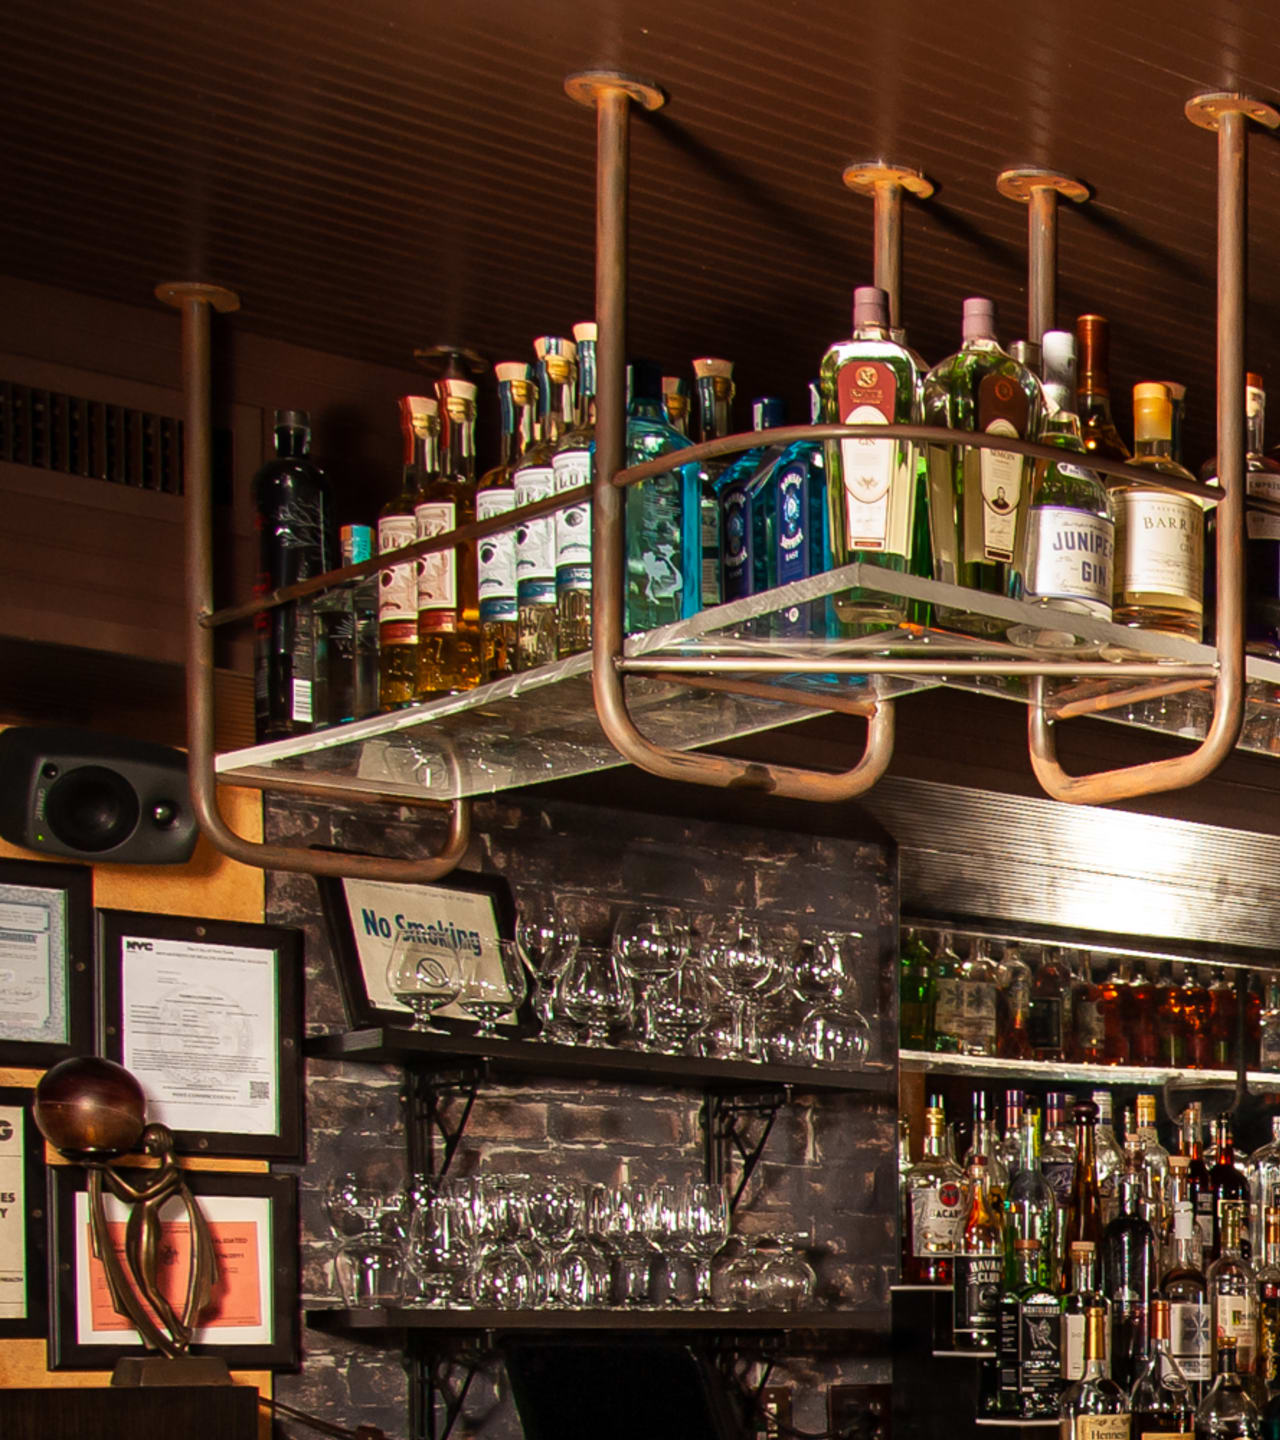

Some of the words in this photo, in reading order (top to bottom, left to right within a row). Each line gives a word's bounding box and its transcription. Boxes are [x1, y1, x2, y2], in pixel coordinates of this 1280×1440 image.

[1081, 560, 1107, 588] GIN
[126, 940, 153, 952] NYC
[361, 908, 392, 939] No
[395, 913, 482, 956] Smoking
